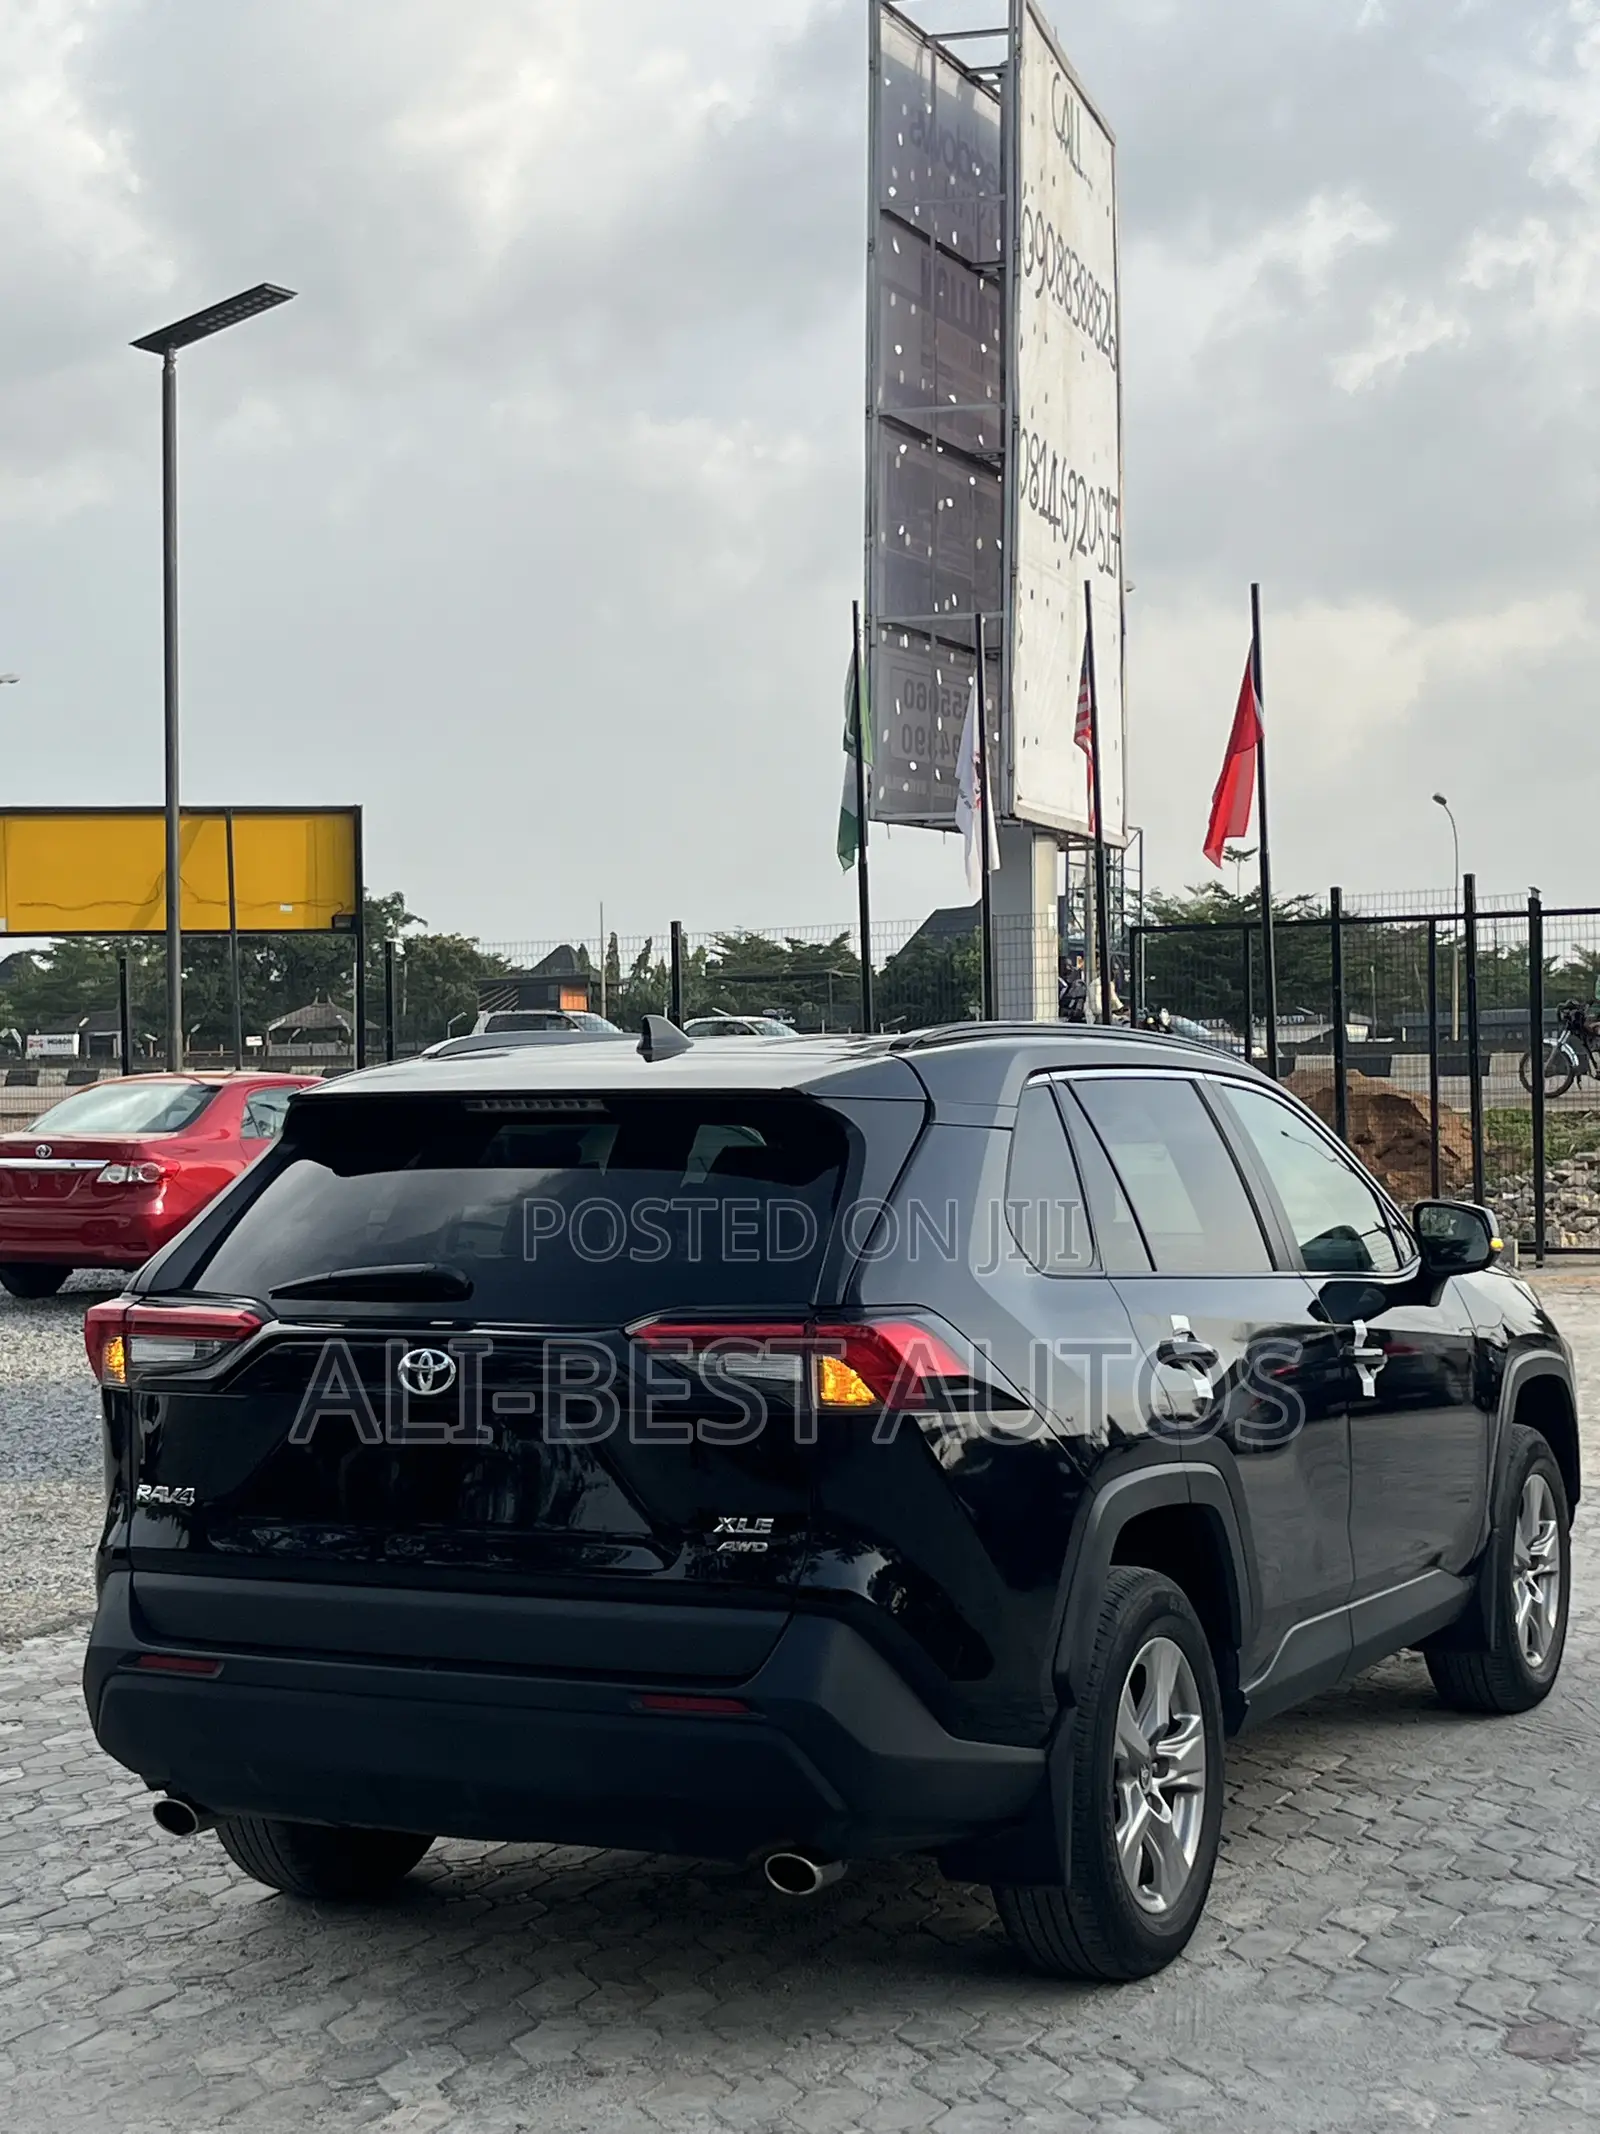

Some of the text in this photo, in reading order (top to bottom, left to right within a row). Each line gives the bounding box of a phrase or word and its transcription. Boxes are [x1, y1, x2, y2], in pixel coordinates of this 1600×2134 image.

[136, 1484, 195, 1507] RAV4
[713, 1516, 774, 1534] XLE
[716, 1541, 769, 1553] AWD
